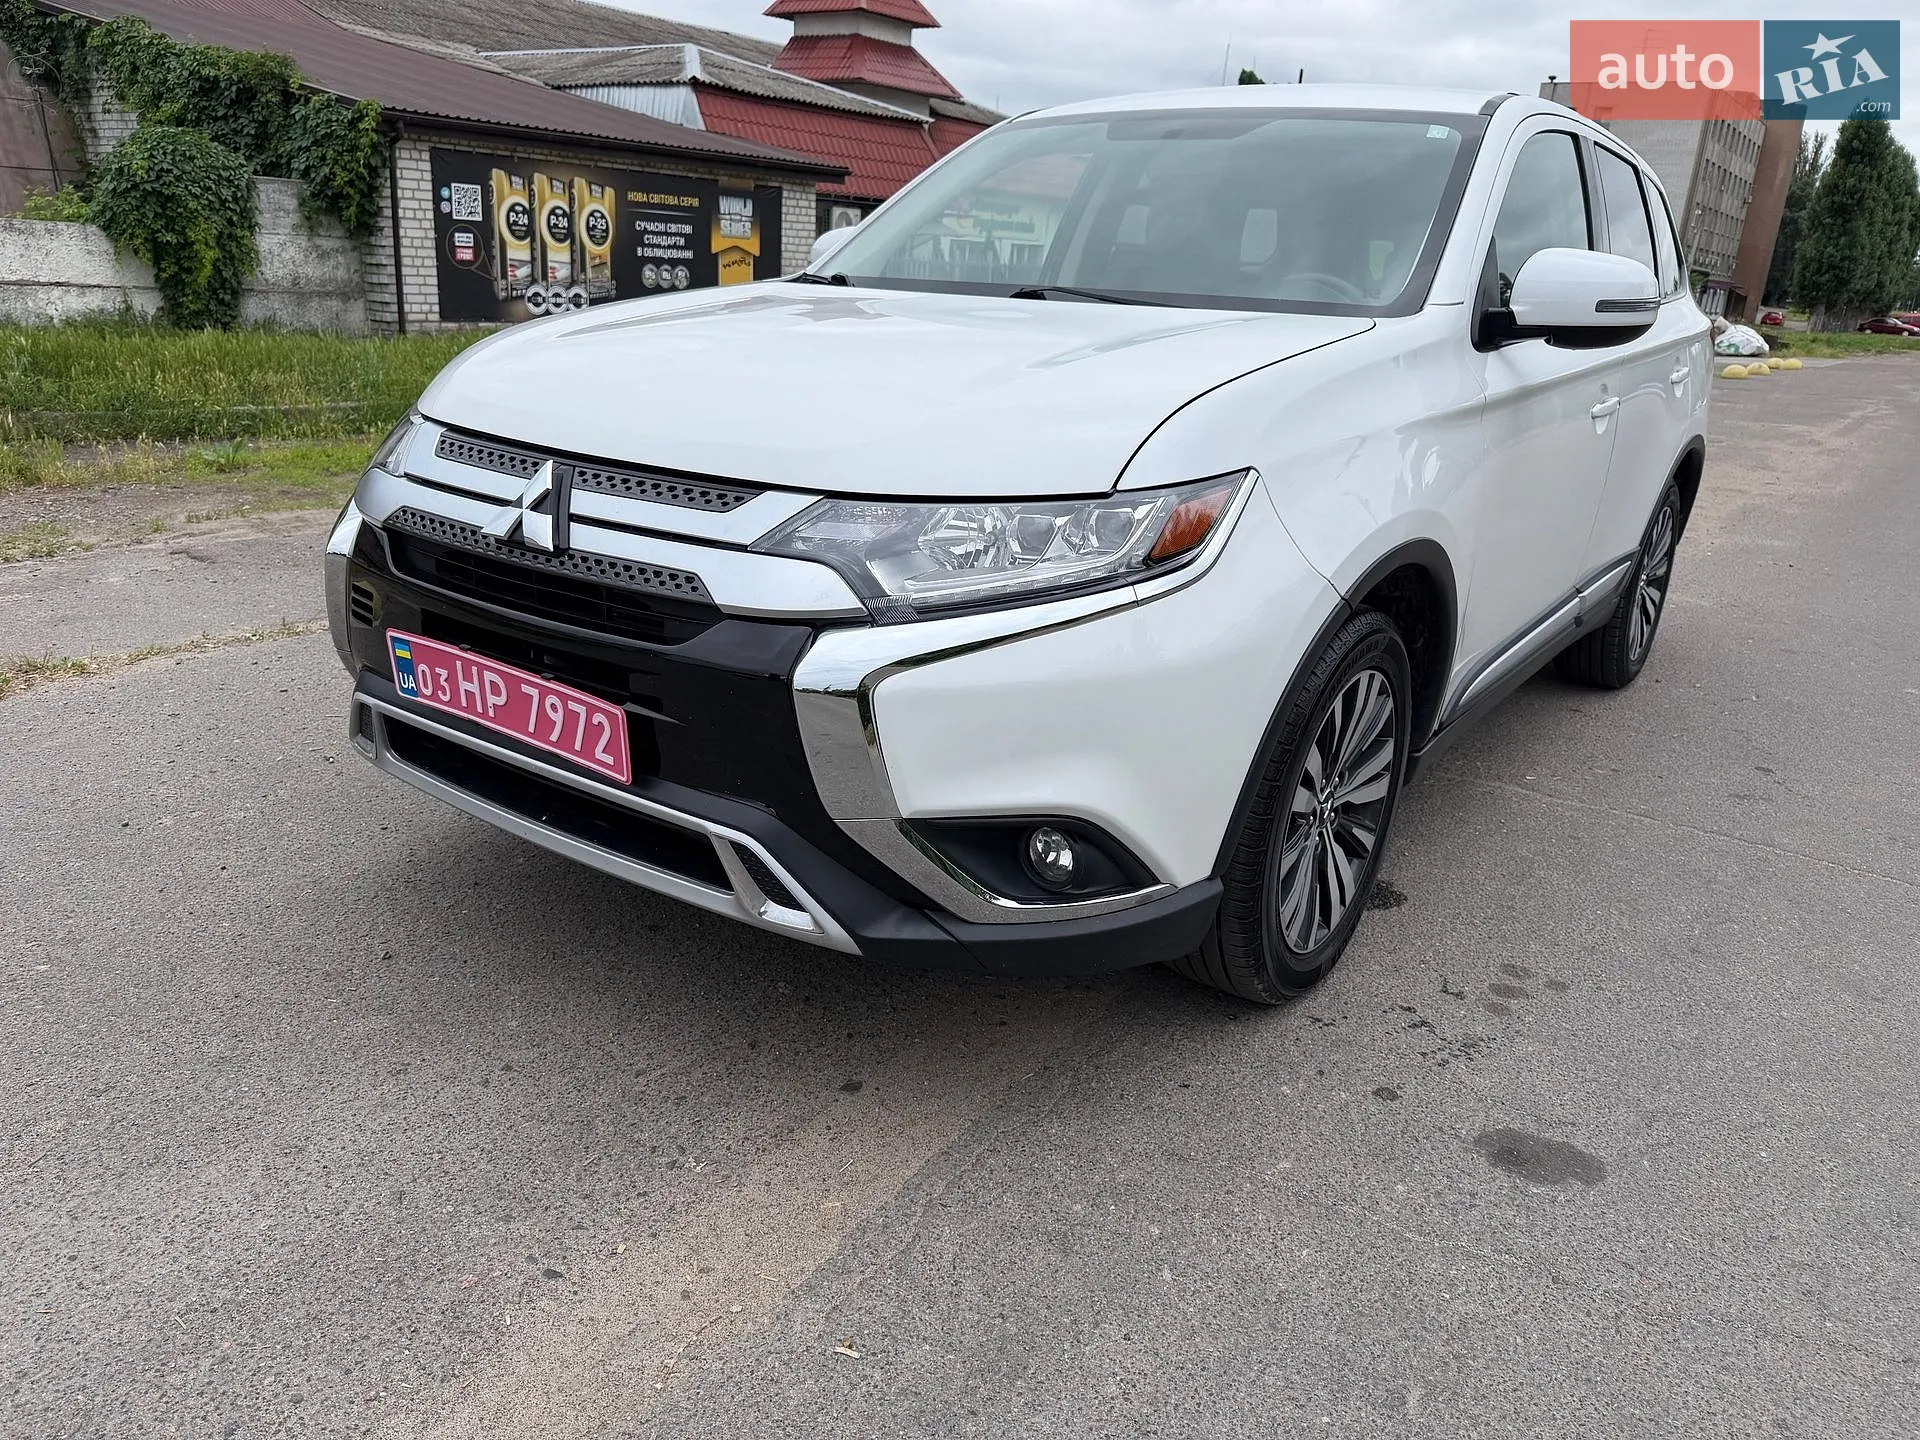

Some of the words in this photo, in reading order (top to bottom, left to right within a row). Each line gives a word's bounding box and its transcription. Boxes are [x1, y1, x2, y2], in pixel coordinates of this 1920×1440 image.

[627, 191, 648, 203] НОВА
[648, 193, 679, 206] СВІТОВА
[679, 195, 700, 208] СЕРІЯ
[635, 220, 665, 232] СУЧАСНІ
[666, 223, 693, 234] СВІТОВІ
[643, 234, 685, 247] СТАНДАРТИ
[637, 246, 642, 257] В
[643, 247, 694, 261] ОБЛИЦЮВАННІ
[399, 671, 417, 692] UA
[417, 663, 452, 702] 03
[455, 660, 508, 718] HP
[521, 683, 615, 766] 7972
